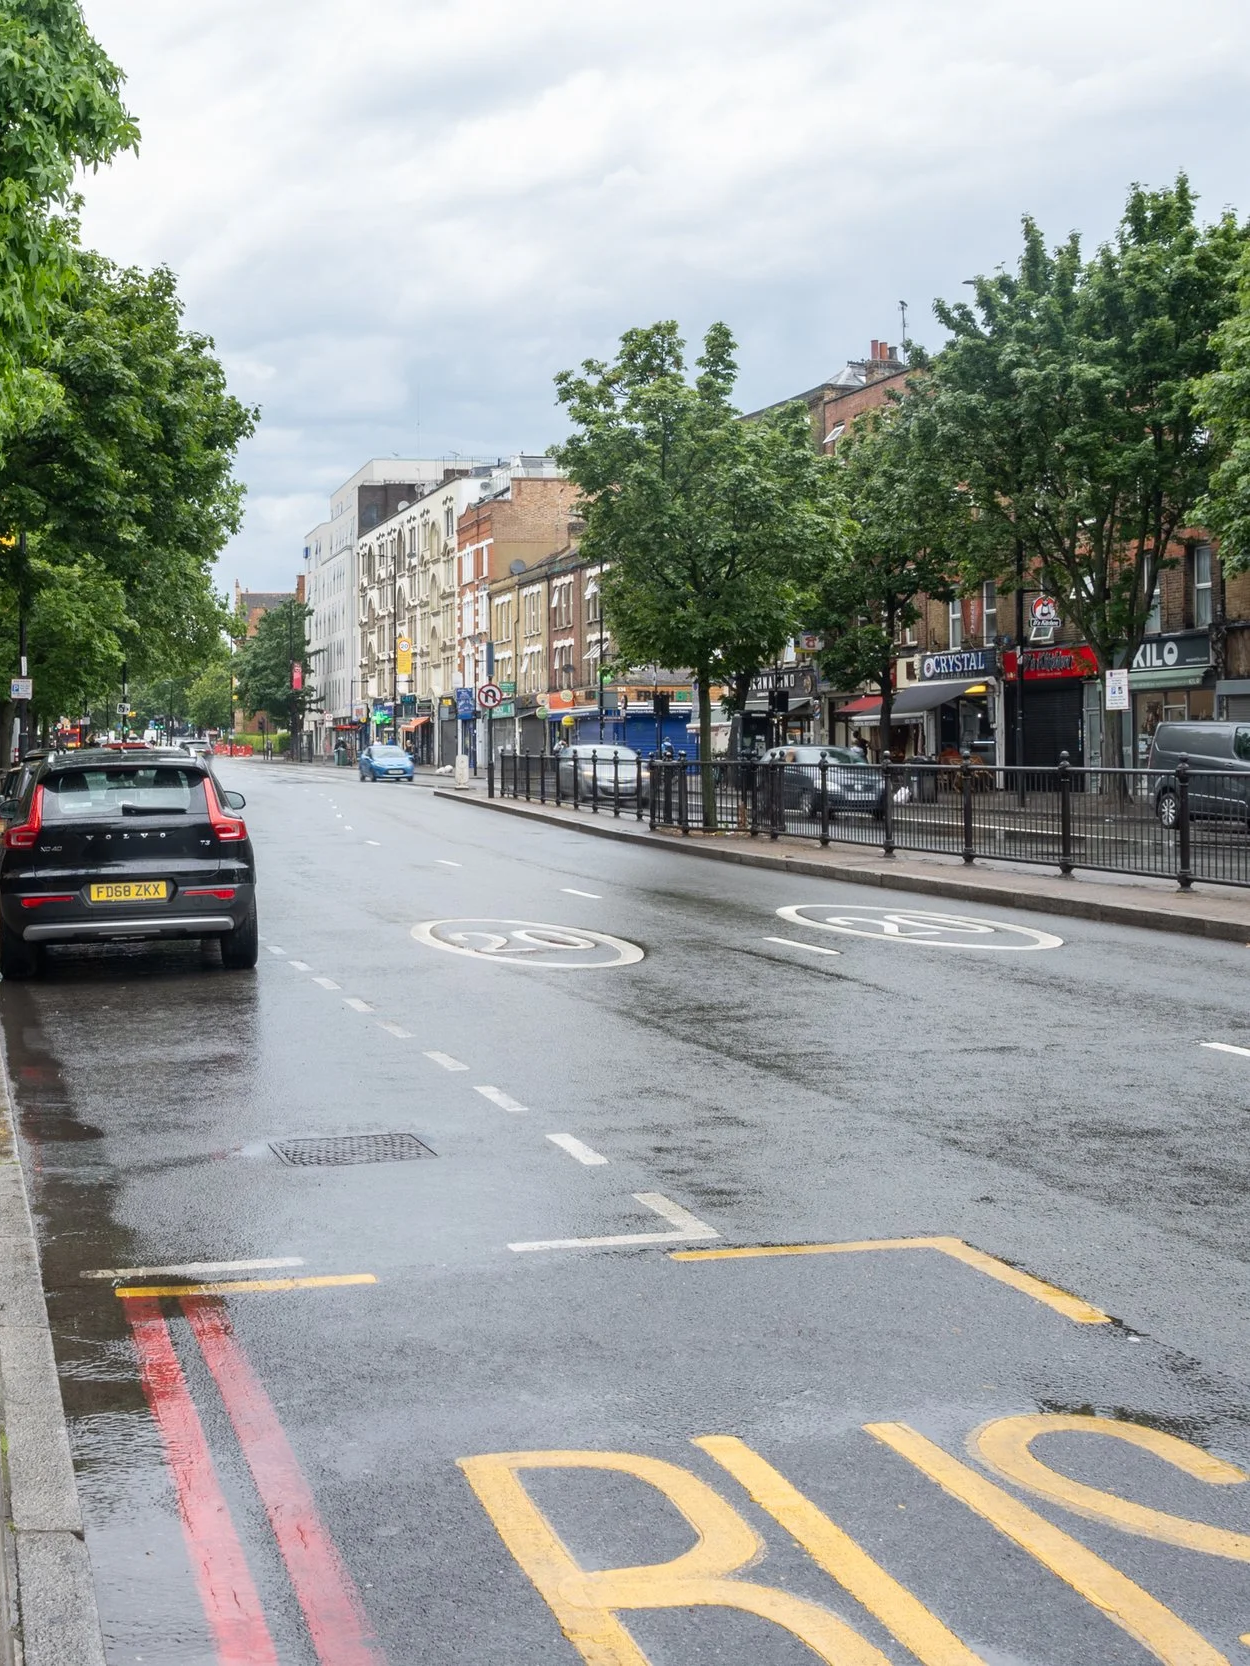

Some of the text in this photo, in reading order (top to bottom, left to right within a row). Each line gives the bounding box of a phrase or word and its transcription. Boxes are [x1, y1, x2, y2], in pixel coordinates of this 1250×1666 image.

[933, 651, 985, 674] CRYSTAL
[1132, 641, 1178, 668] KILO
[86, 832, 166, 841] VOLVO
[134, 883, 161, 897] ZKX
